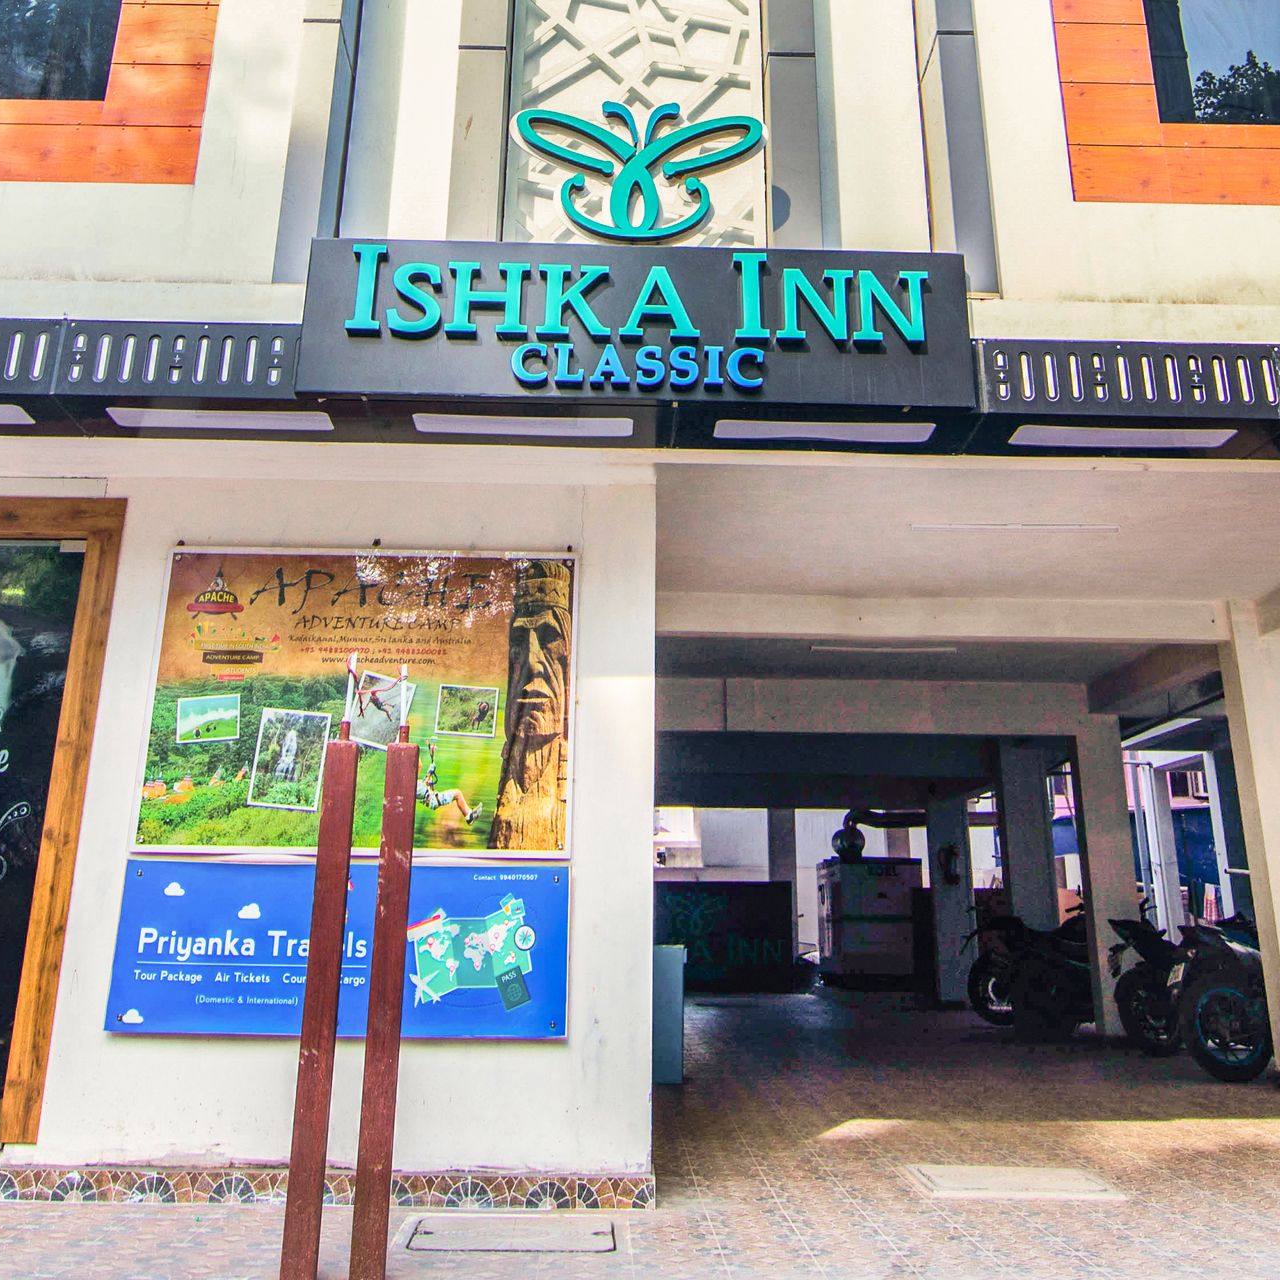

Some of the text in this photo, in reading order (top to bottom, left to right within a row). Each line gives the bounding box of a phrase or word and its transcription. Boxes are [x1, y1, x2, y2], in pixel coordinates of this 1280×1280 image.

[344, 243, 929, 345] ISHKA INN
[510, 342, 765, 389] CLASSIC
[198, 591, 235, 604] APACHE
[250, 567, 494, 615] APACHE
[294, 615, 462, 633] ADVENTURE CAMP
[322, 656, 436, 665] www.acheadventure.com
[137, 927, 368, 961] Priyanka Trals
[134, 969, 157, 982] Tour
[160, 971, 203, 985] Package
[214, 971, 230, 983] Air
[234, 972, 271, 984] Tickets
[282, 972, 307, 984] Cour
[501, 971, 517, 983] PASS
[195, 995, 299, 1006] (Domestic & International)
